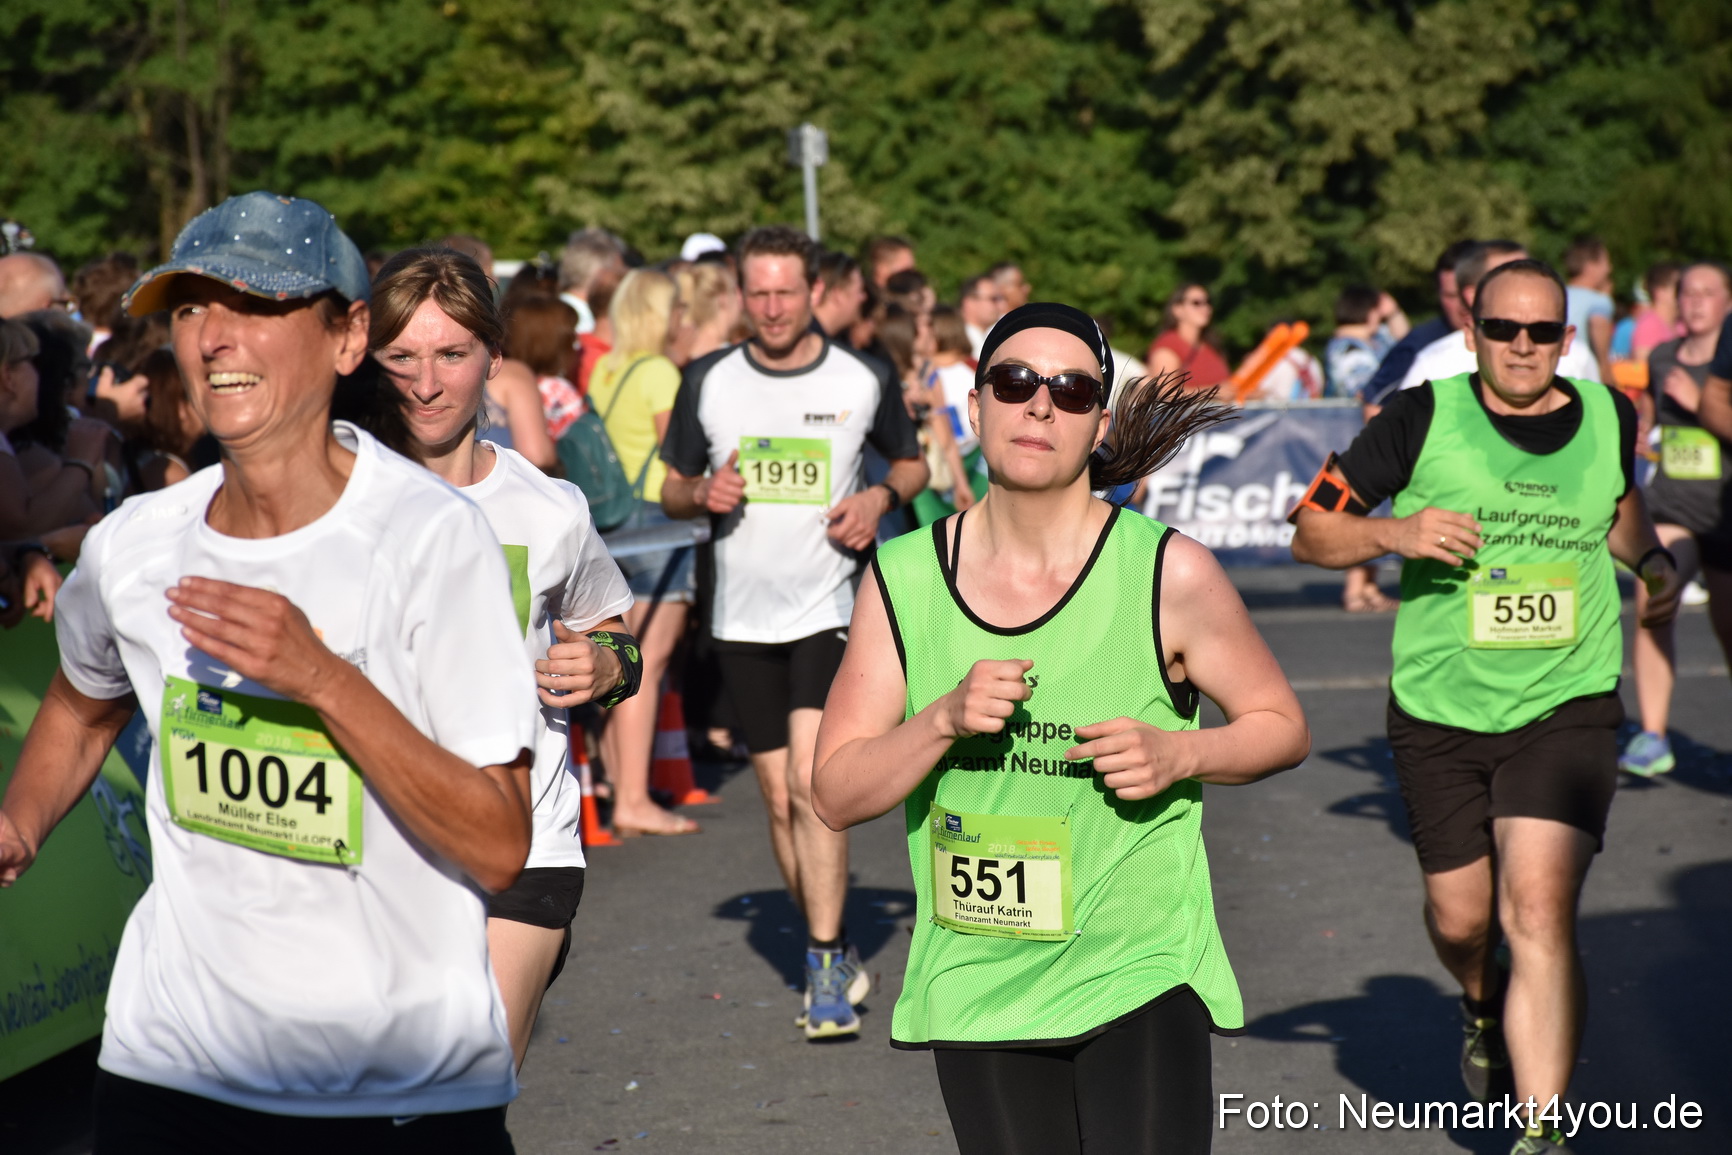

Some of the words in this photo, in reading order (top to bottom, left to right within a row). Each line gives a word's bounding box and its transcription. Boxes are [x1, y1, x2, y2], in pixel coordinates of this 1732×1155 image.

[752, 461, 817, 485] 1919
[1477, 508, 1581, 530] Laufgruppe
[1530, 534, 1599, 552] Neumark
[1494, 593, 1557, 624] 550
[974, 721, 1072, 745] gruppe
[1011, 751, 1097, 780] Neuma
[185, 742, 333, 815] 1004
[186, 810, 245, 832] Landratsamt
[246, 822, 294, 842] Neumarkt
[218, 802, 261, 823] Müller
[266, 811, 298, 830] Else
[939, 825, 982, 844] firmenlauf
[987, 842, 1016, 854] 2018
[950, 854, 1027, 904] 551
[953, 899, 995, 916] Thürauf
[997, 904, 1033, 919] Katrin
[954, 911, 993, 925] Finanzamt
[993, 917, 1032, 929] Neumarkt
